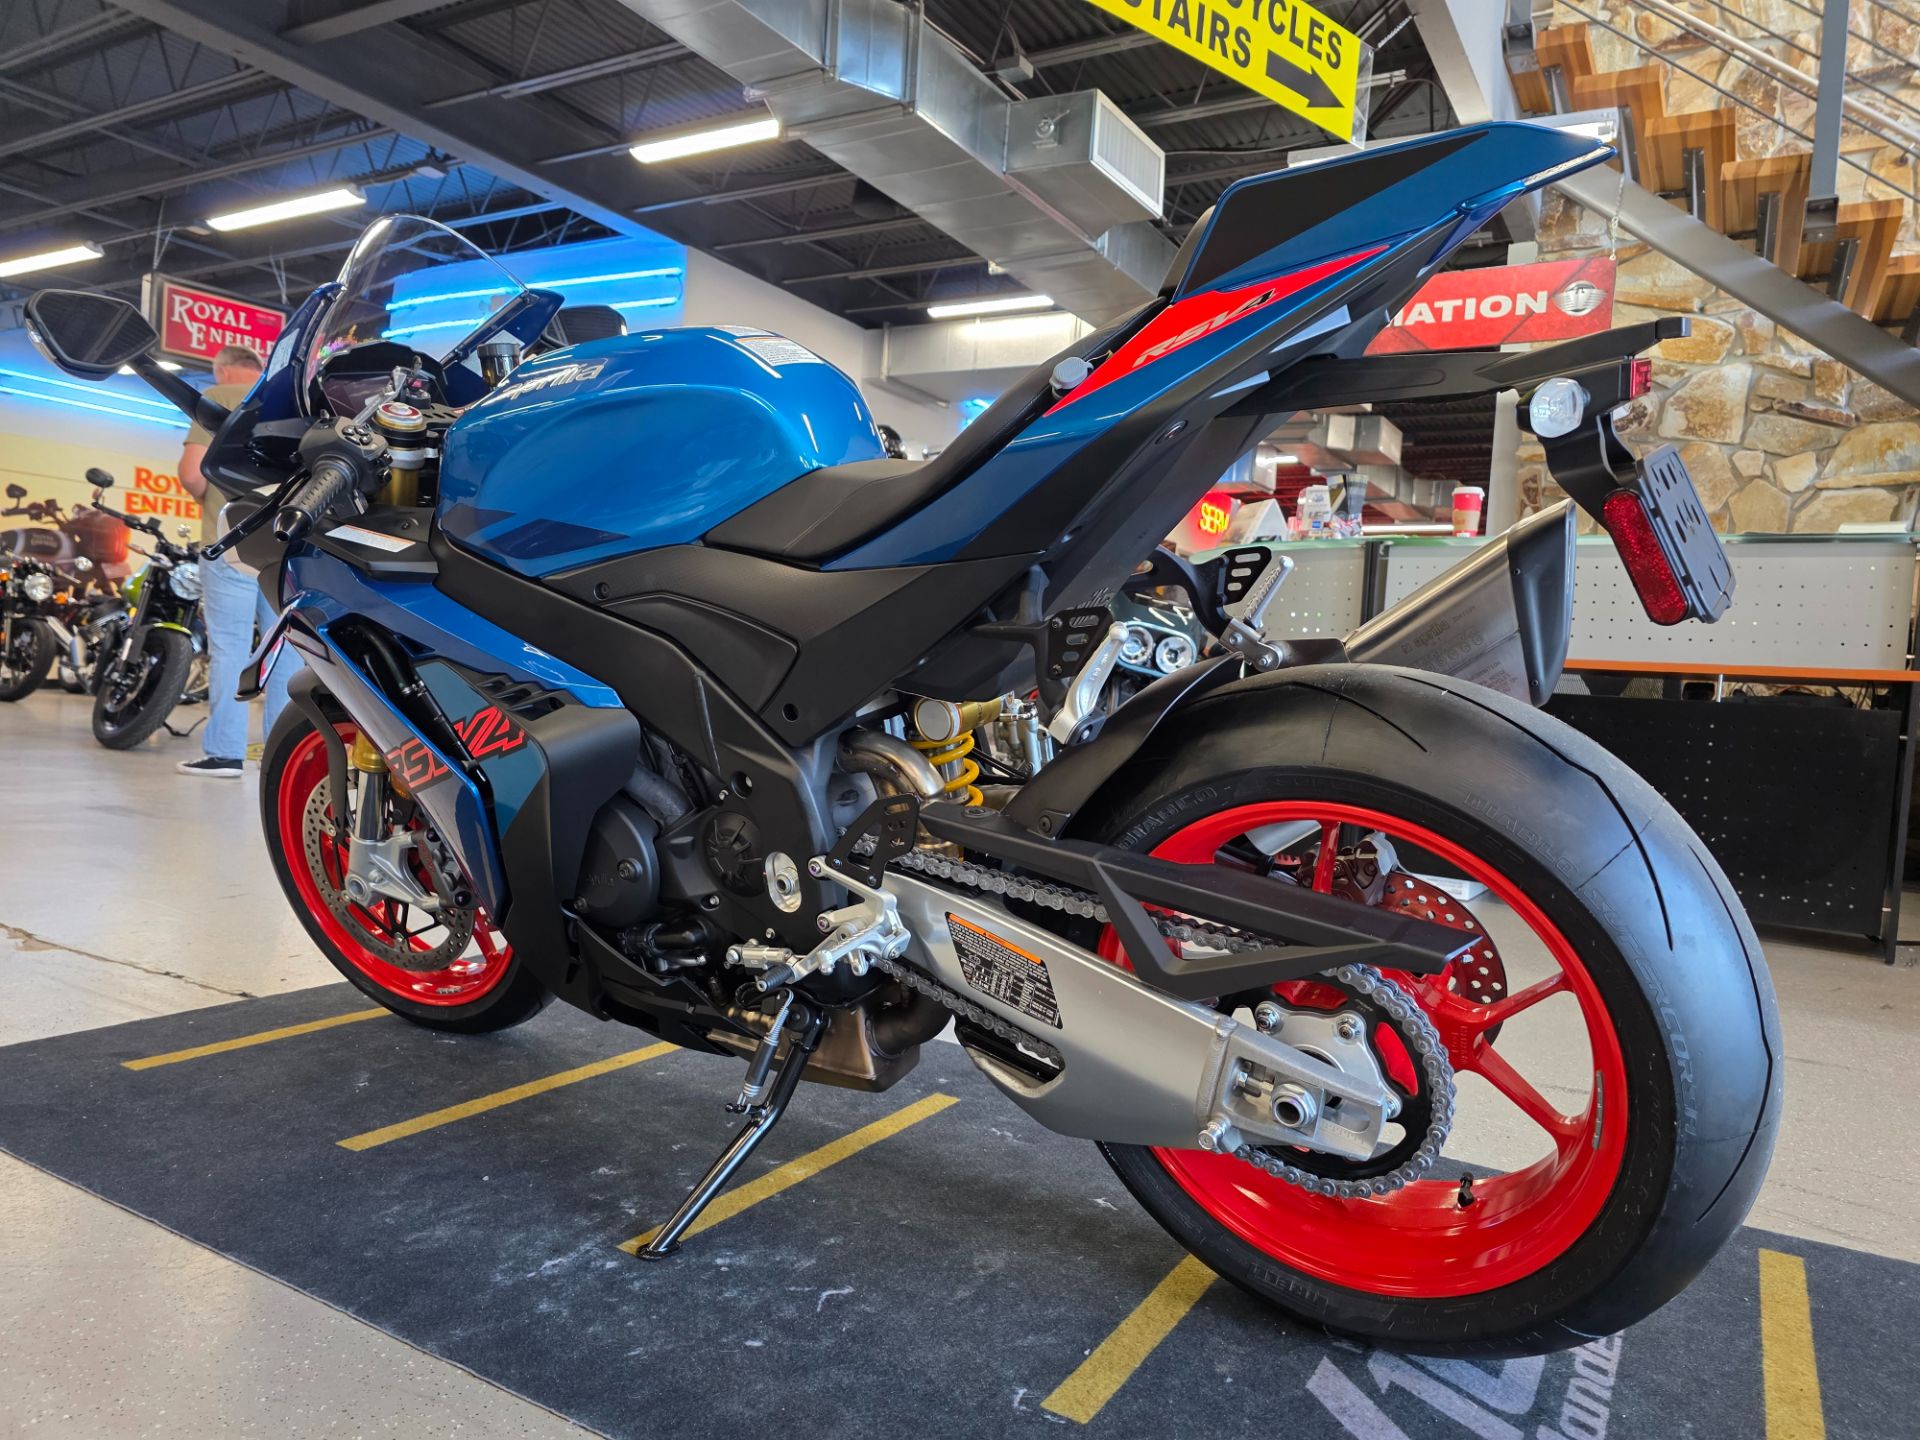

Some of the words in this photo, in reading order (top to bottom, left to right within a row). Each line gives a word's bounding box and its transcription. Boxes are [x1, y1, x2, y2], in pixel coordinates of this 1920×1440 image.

[1121, 0, 1252, 69] TAIRS
[1223, 0, 1342, 70] YCLES
[171, 294, 252, 332] ROYAL
[134, 466, 191, 497] ROY
